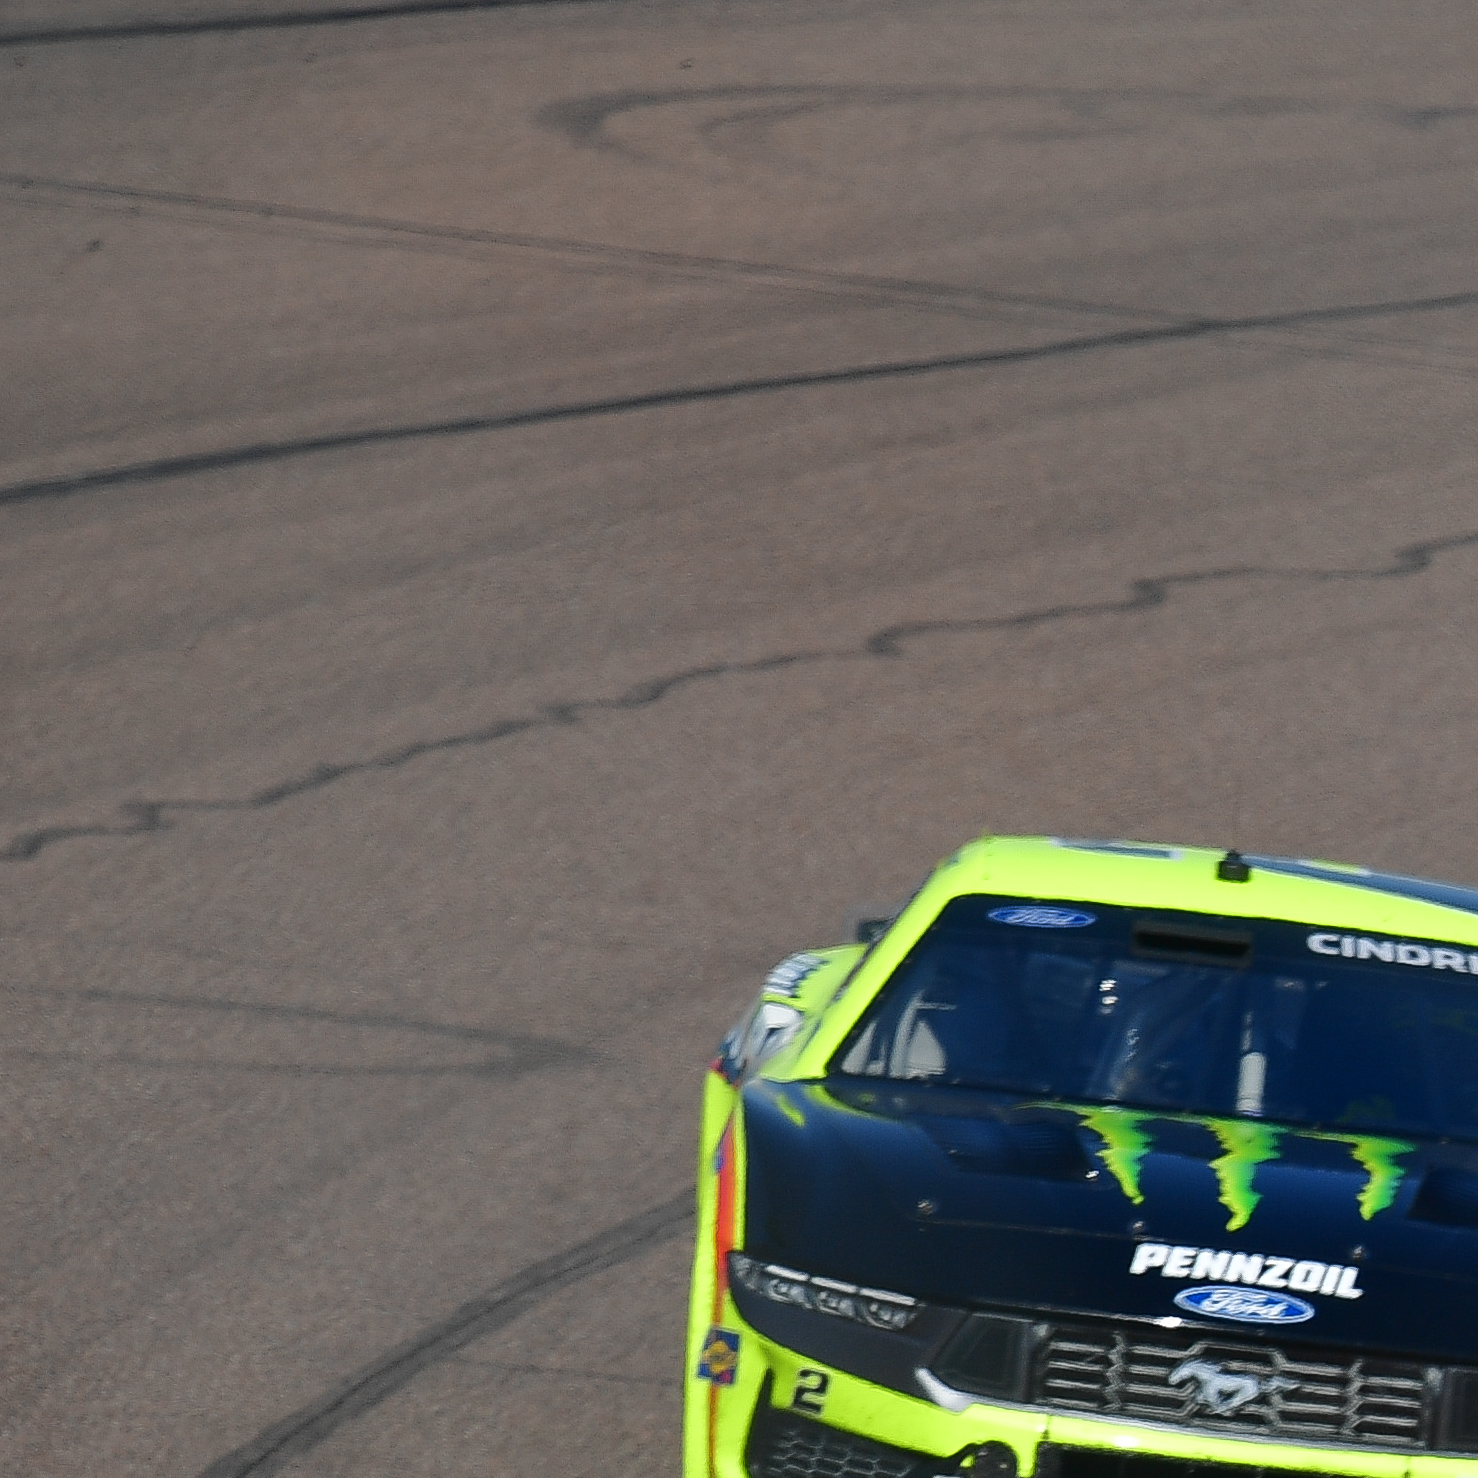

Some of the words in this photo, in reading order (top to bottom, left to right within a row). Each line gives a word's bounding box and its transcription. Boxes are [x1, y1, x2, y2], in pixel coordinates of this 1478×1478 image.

[1129, 1242, 1364, 1299] PENNZOIL
[1199, 1288, 1294, 1320] Ford
[793, 1368, 829, 1414] 2
